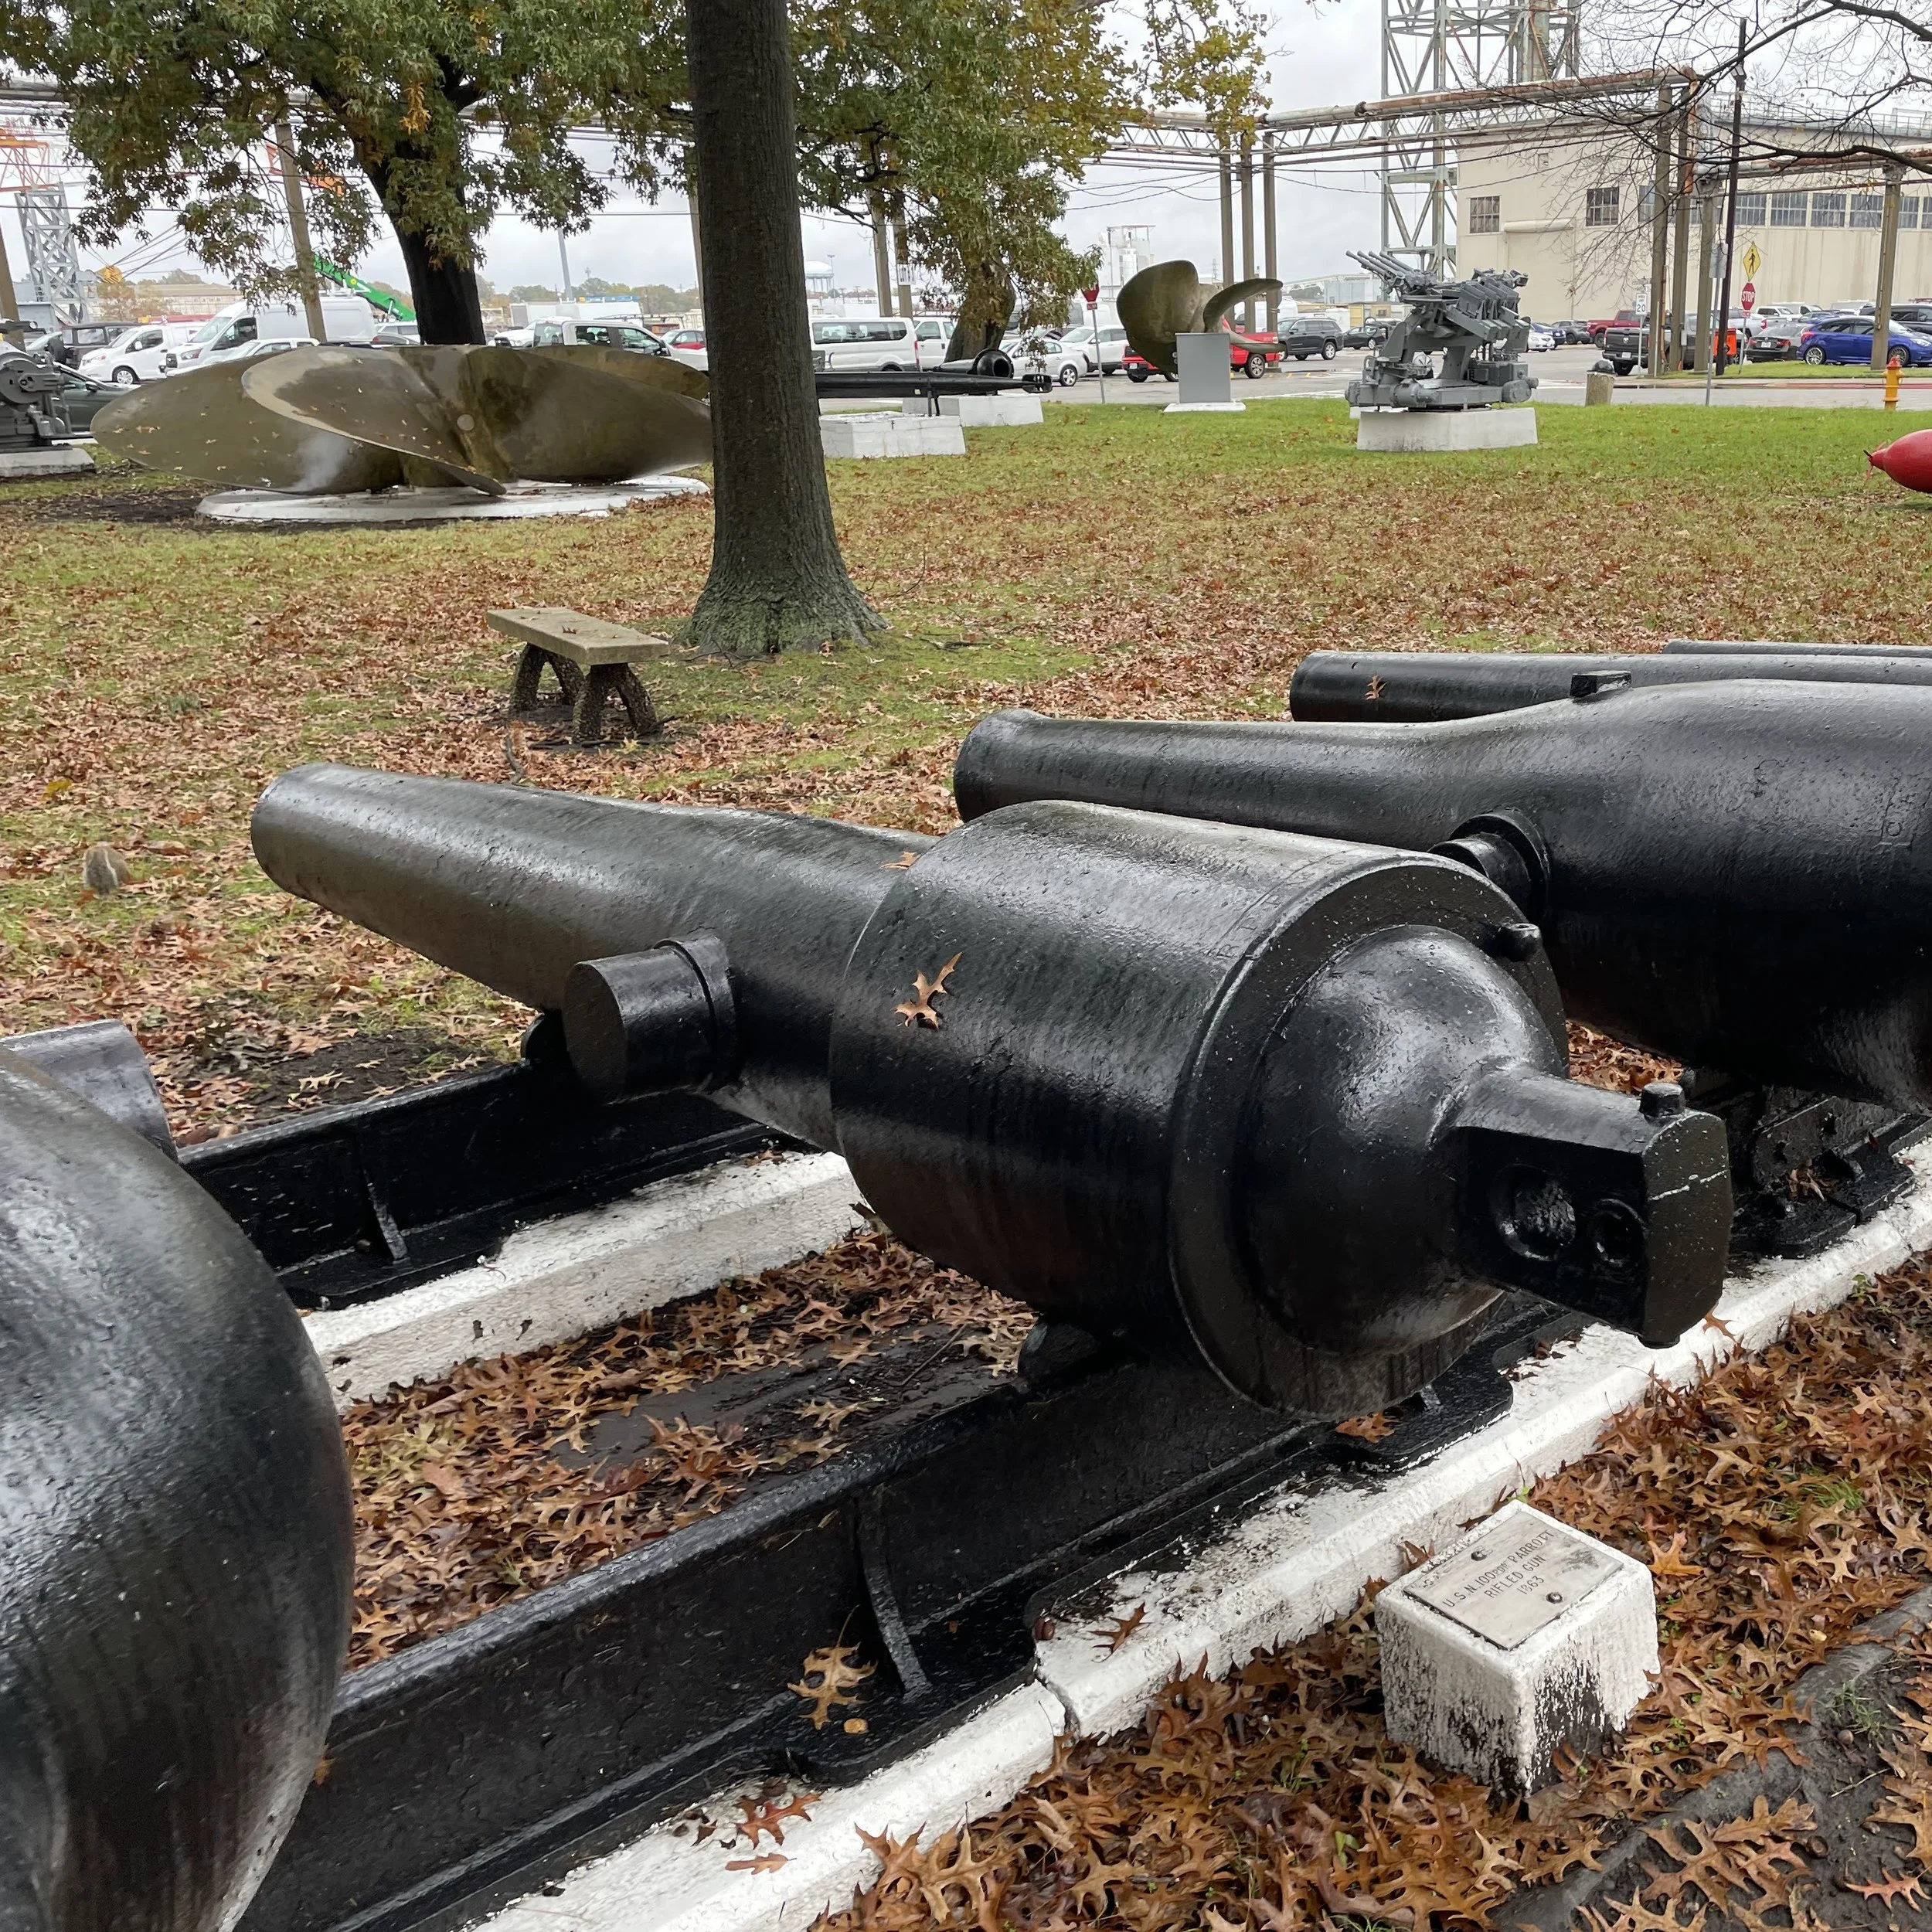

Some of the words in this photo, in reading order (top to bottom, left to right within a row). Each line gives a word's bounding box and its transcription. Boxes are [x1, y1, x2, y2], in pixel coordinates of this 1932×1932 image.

[1742, 291, 1755, 302] STOP
[1637, 304, 1646, 312] 20
[1507, 1530, 1555, 1563] PARROTT
[1484, 1571, 1524, 1599] RIFLED
[1522, 1555, 1546, 1572] GUN
[1517, 1575, 1545, 1595] 1863
